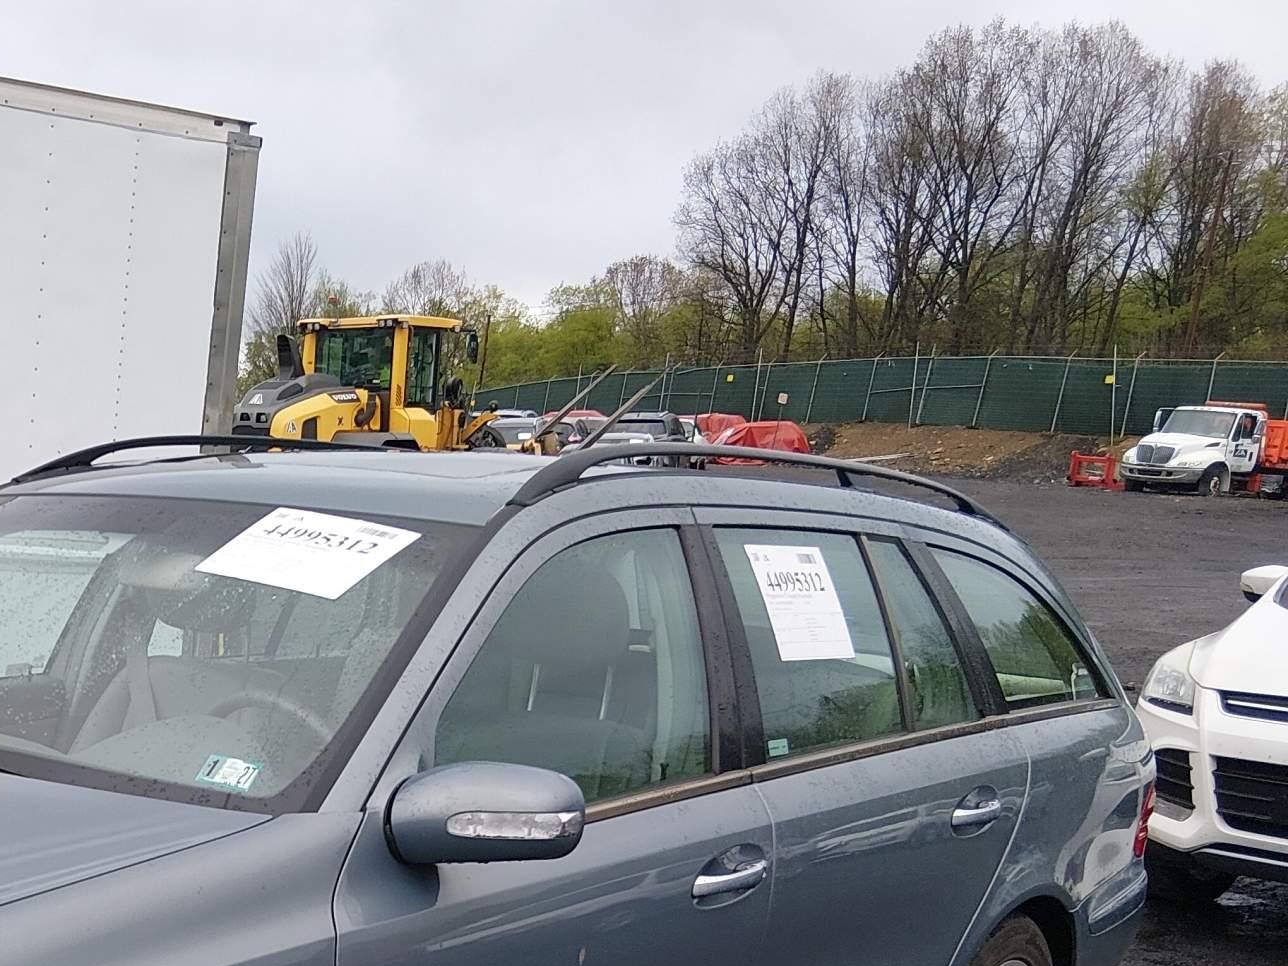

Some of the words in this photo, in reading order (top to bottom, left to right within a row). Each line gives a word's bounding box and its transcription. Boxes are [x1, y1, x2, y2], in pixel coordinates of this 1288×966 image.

[332, 392, 358, 401] VOLVO
[264, 524, 378, 554] 44995312
[766, 571, 825, 592] 44995312
[205, 759, 220, 777] 1
